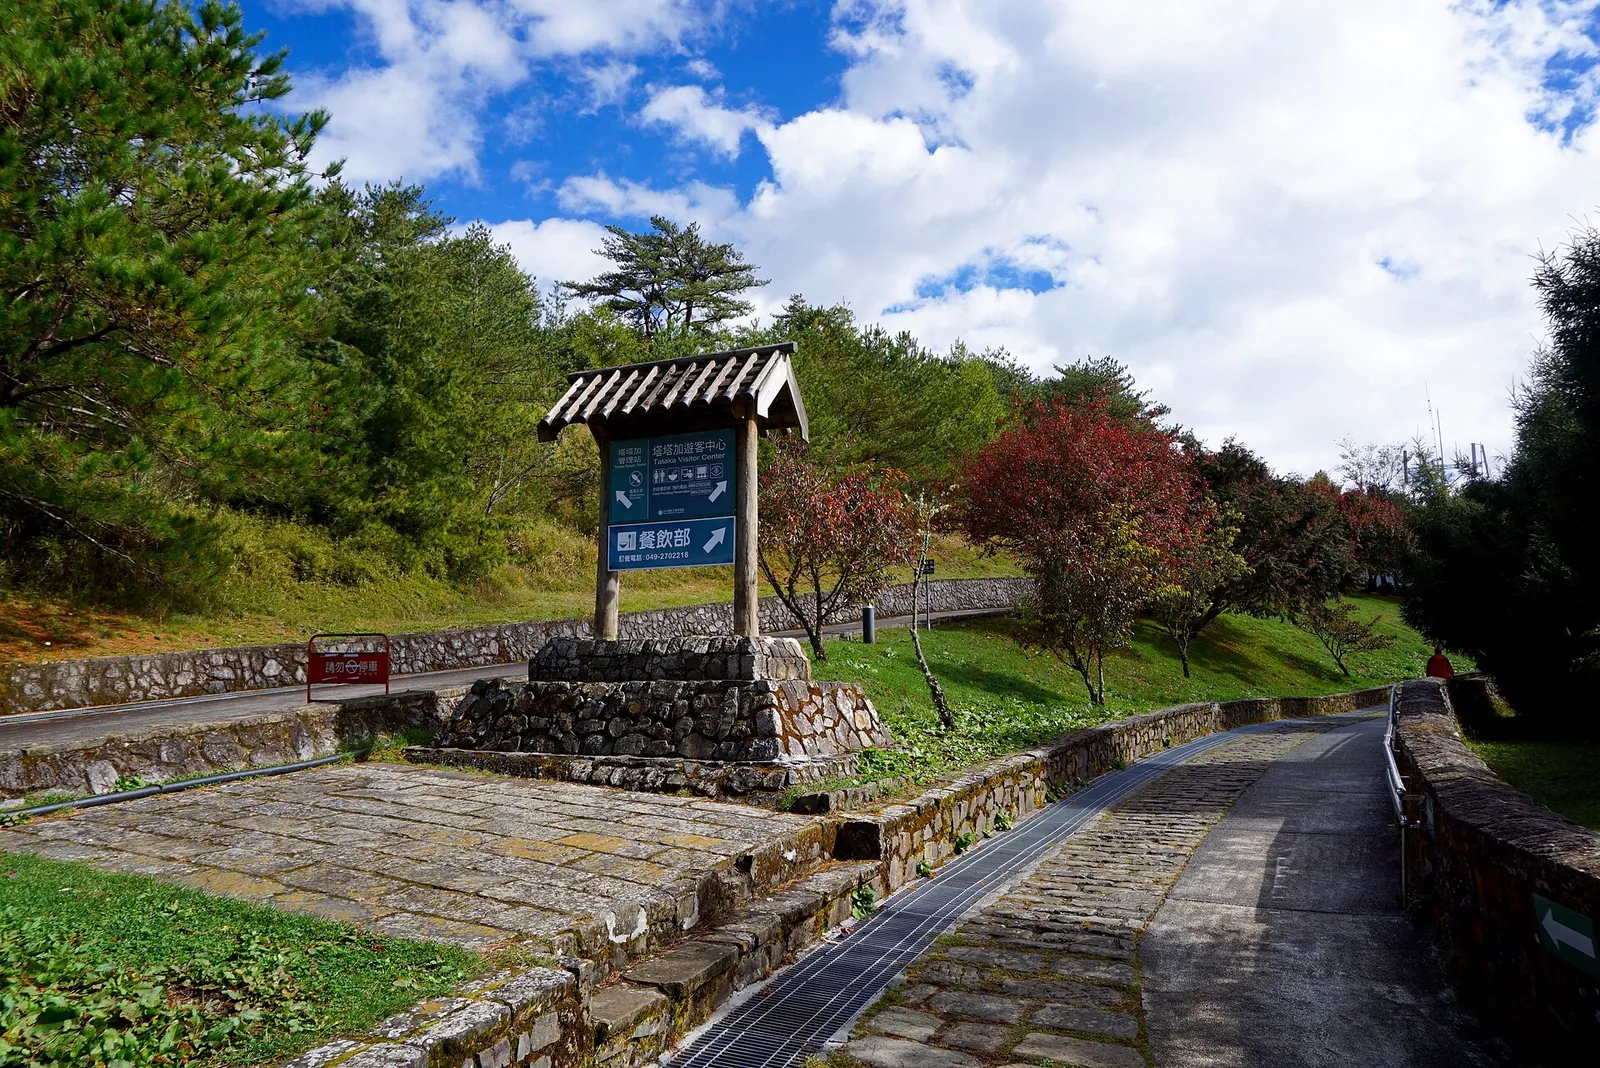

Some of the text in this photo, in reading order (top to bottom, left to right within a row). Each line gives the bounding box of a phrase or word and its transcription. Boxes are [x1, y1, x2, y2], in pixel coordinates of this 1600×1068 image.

[618, 447, 642, 456] 塔塔加
[652, 438, 727, 457] 塔塔加遊客中心
[618, 455, 642, 465] 管理站
[678, 455, 700, 463] Visitor
[701, 453, 726, 461] Center
[639, 527, 691, 550] 餐飲部
